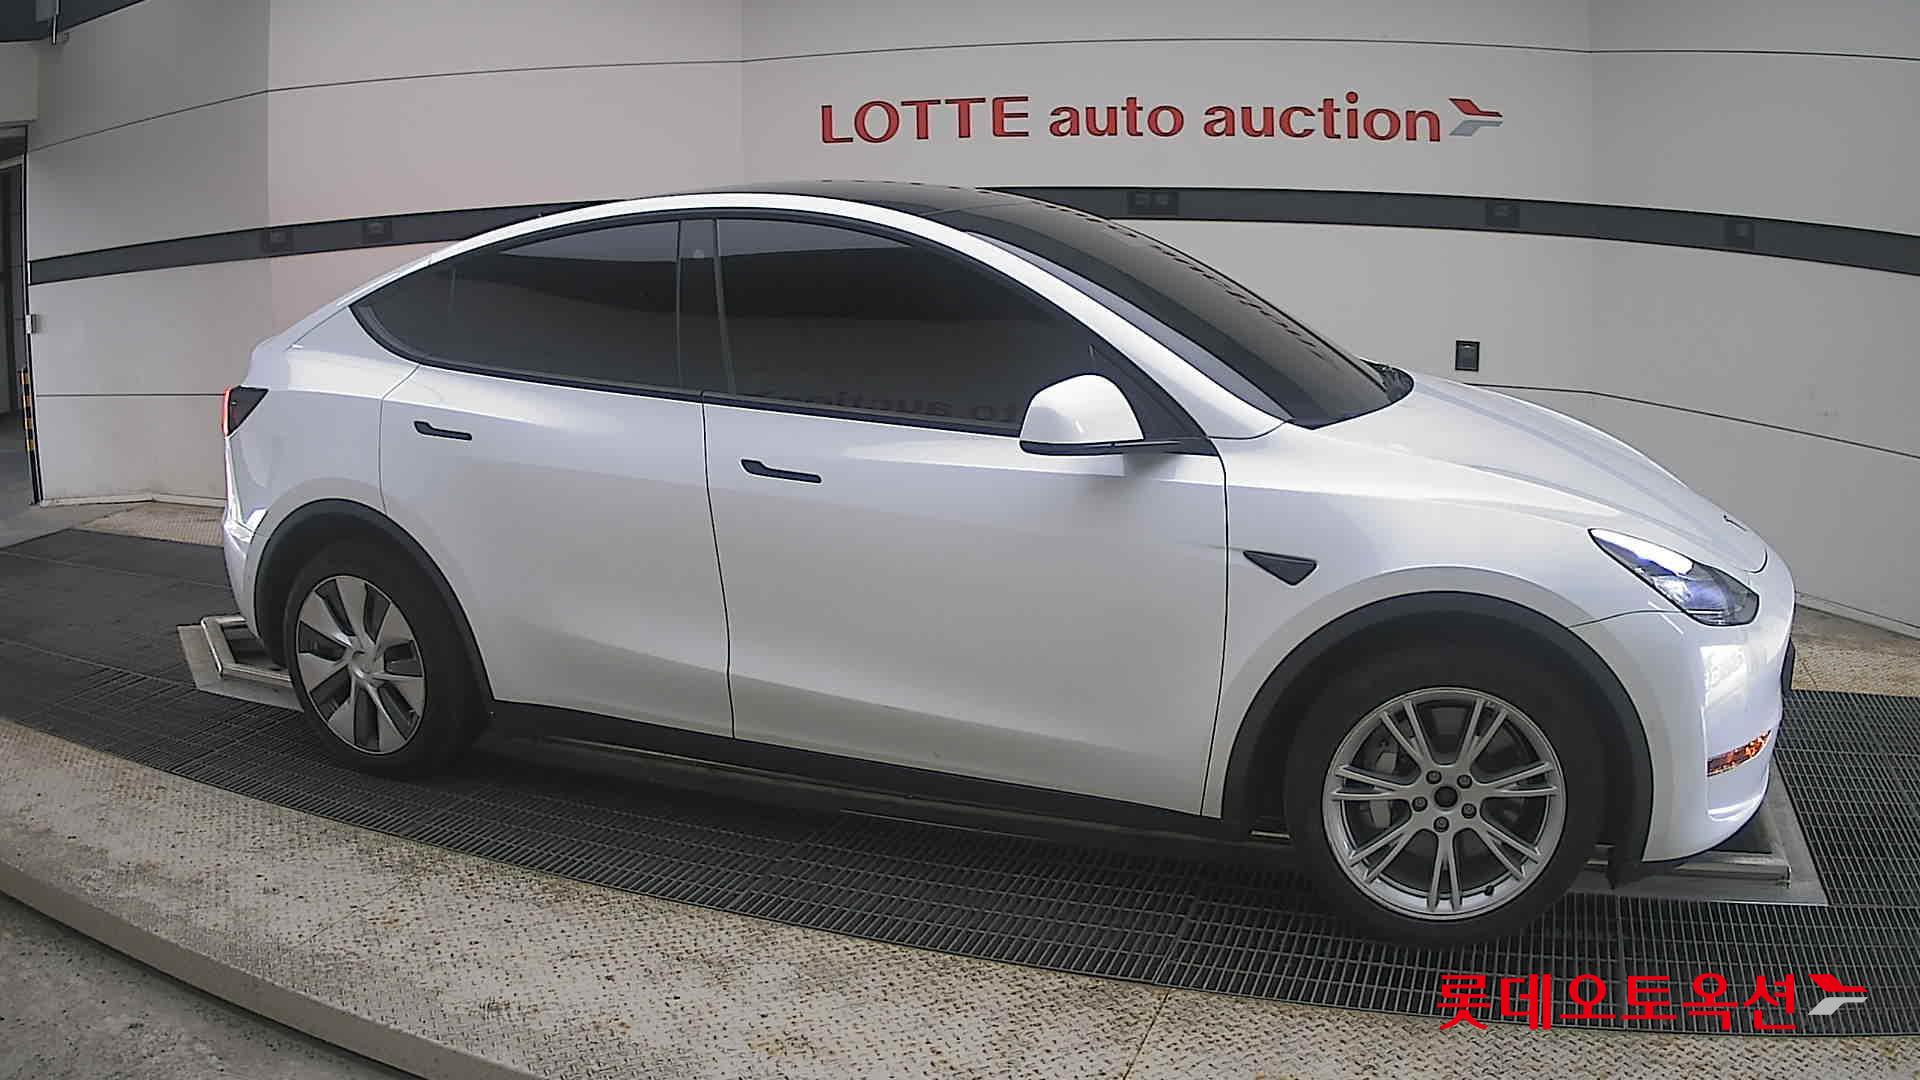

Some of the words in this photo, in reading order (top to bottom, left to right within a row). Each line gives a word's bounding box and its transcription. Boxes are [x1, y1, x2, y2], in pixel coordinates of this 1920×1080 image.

[821, 96, 1029, 143] LOTTE
[1049, 97, 1185, 137] auto
[1203, 91, 1441, 141] auction
